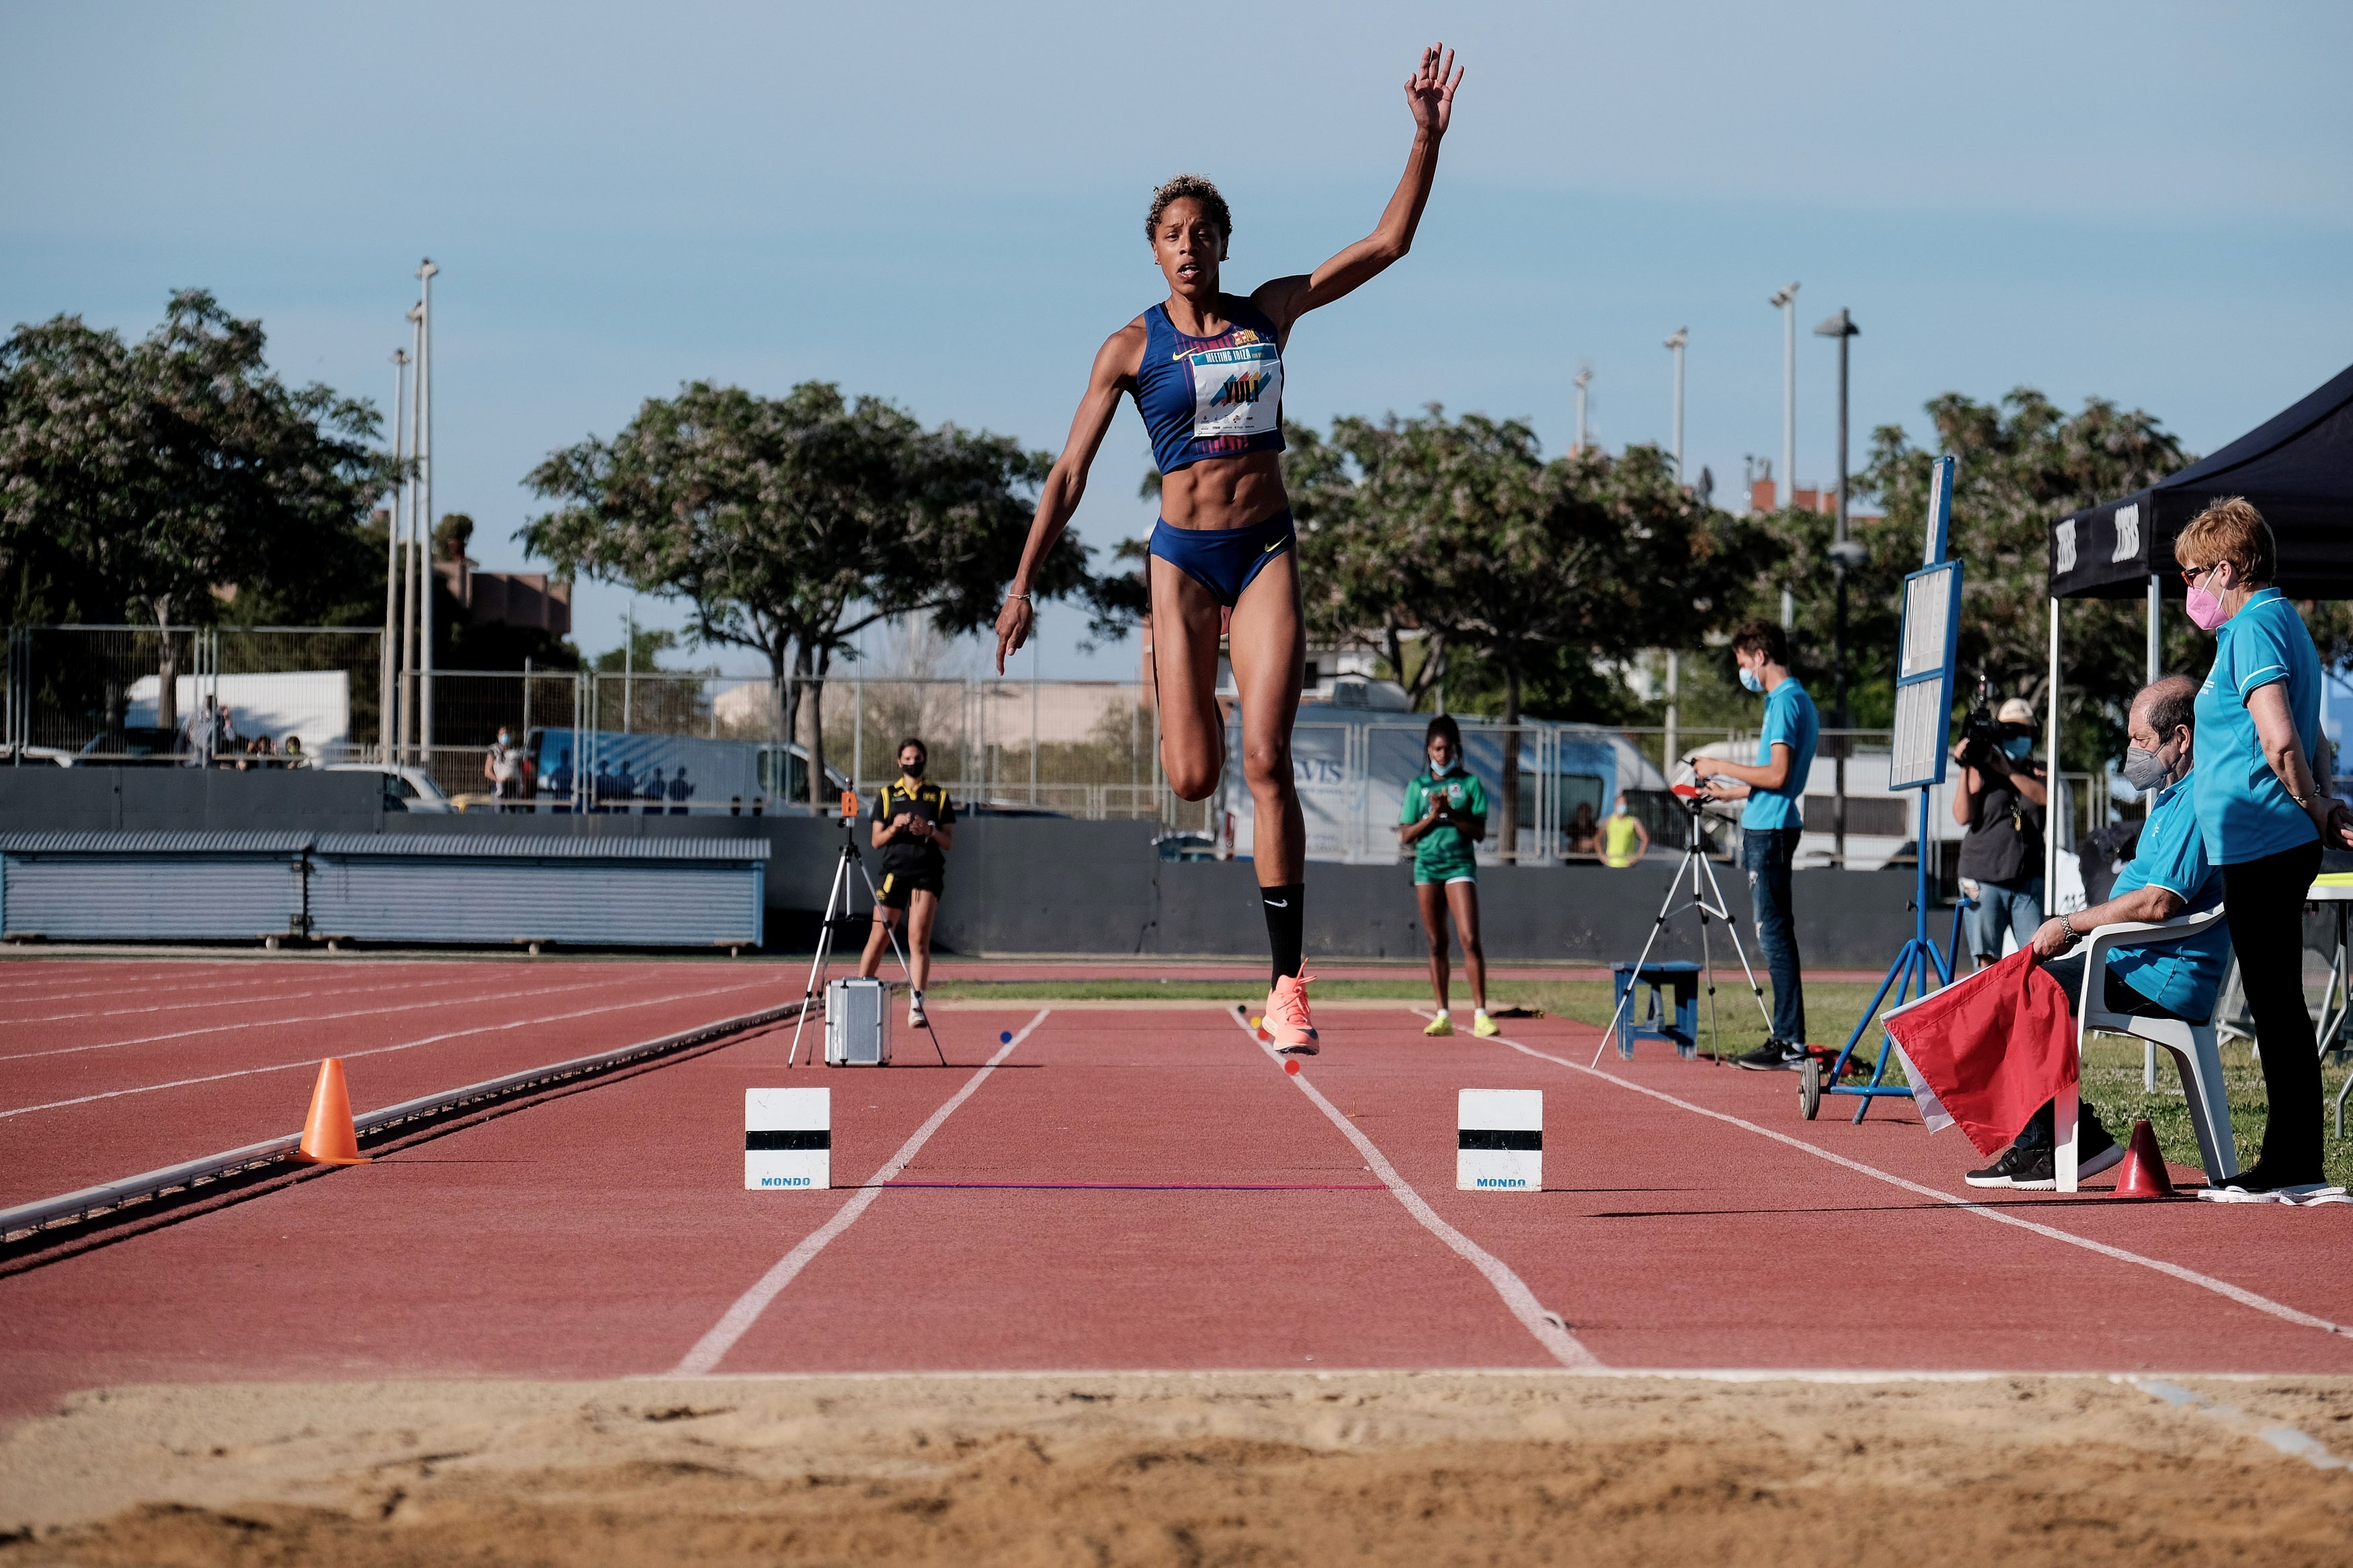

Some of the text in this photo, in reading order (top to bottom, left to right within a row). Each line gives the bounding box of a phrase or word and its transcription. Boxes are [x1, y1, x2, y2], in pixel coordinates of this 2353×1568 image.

[1205, 351, 1232, 363] MEETING
[1233, 348, 1251, 360] IBIZA
[1224, 380, 1259, 403] YULI
[761, 1178, 811, 1186] MONDO
[1476, 1178, 1526, 1188] MONDO
